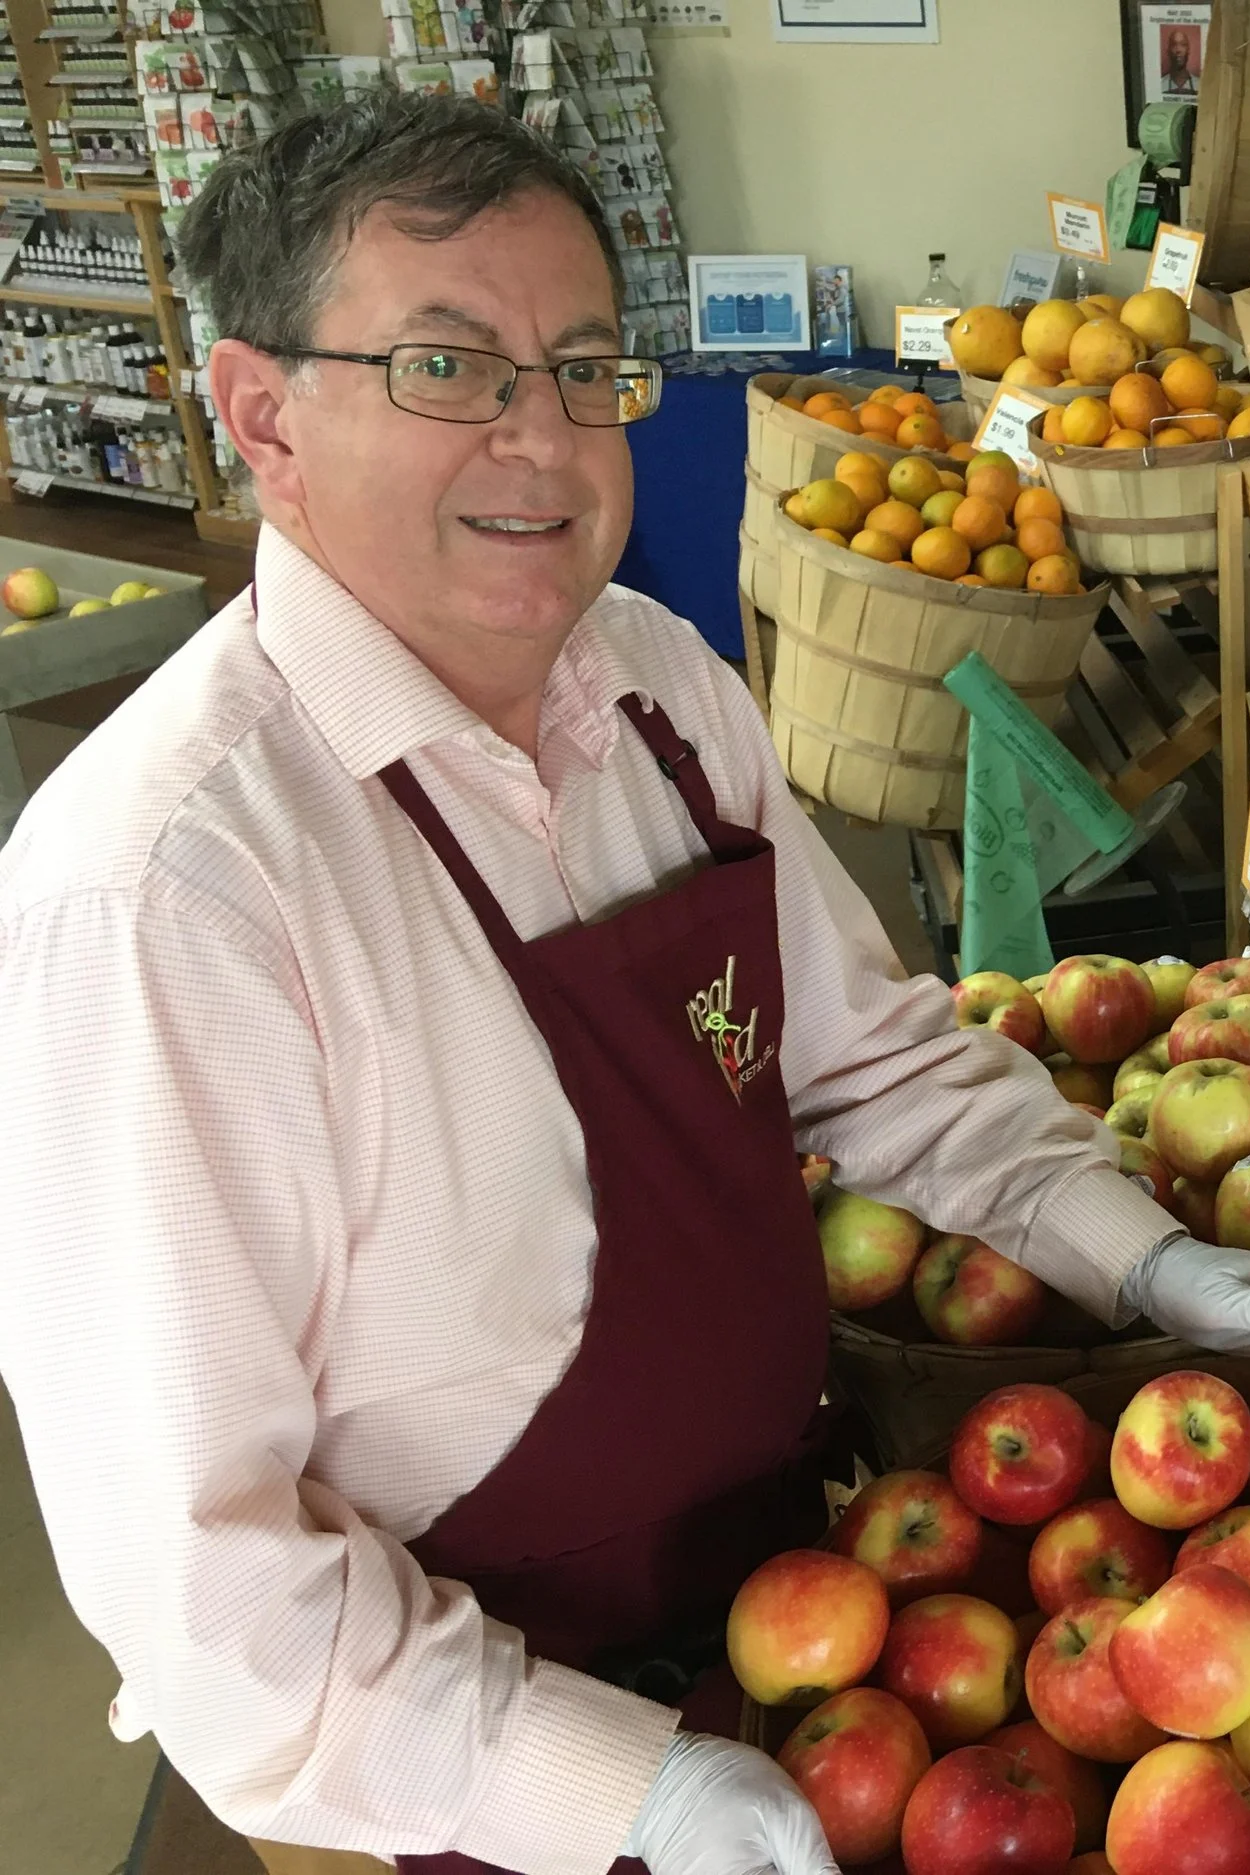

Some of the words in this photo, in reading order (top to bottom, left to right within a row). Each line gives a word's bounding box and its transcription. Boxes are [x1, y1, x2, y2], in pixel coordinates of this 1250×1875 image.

[923, 326, 943, 335] Orang
[902, 340, 931, 352] $2.29
[997, 407, 1024, 426] Valencia
[990, 422, 1015, 439] $1.99
[686, 955, 736, 1042] real
